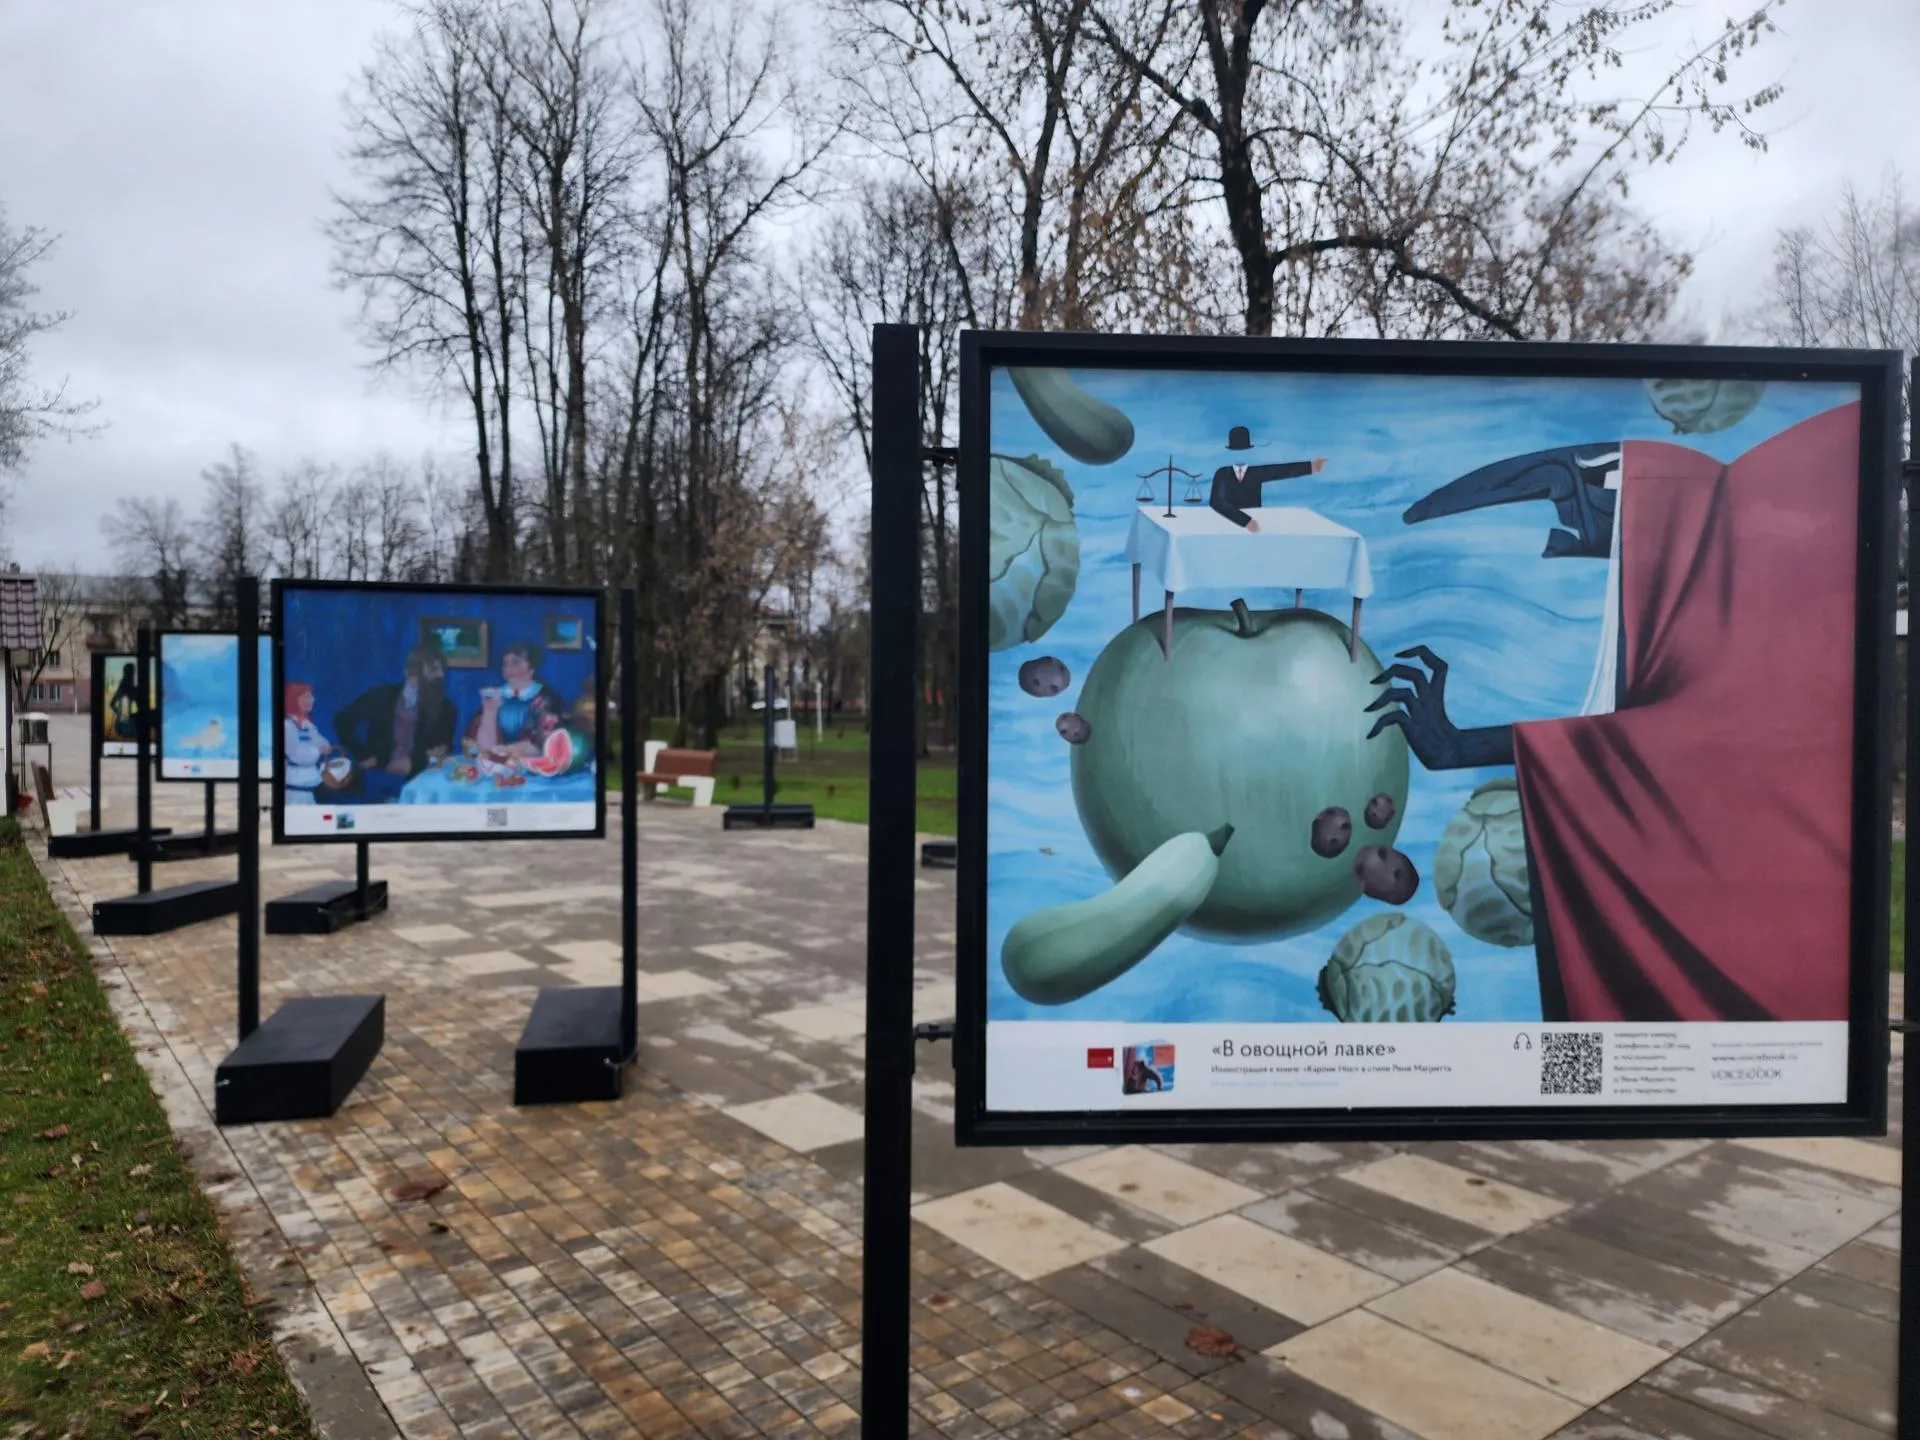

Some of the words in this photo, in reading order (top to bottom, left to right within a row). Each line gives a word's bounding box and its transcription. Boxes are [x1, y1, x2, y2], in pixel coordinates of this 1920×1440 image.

[1212, 1039, 1234, 1057] «В
[1240, 1040, 1328, 1059] овощной
[1334, 1043, 1396, 1057] лавке»
